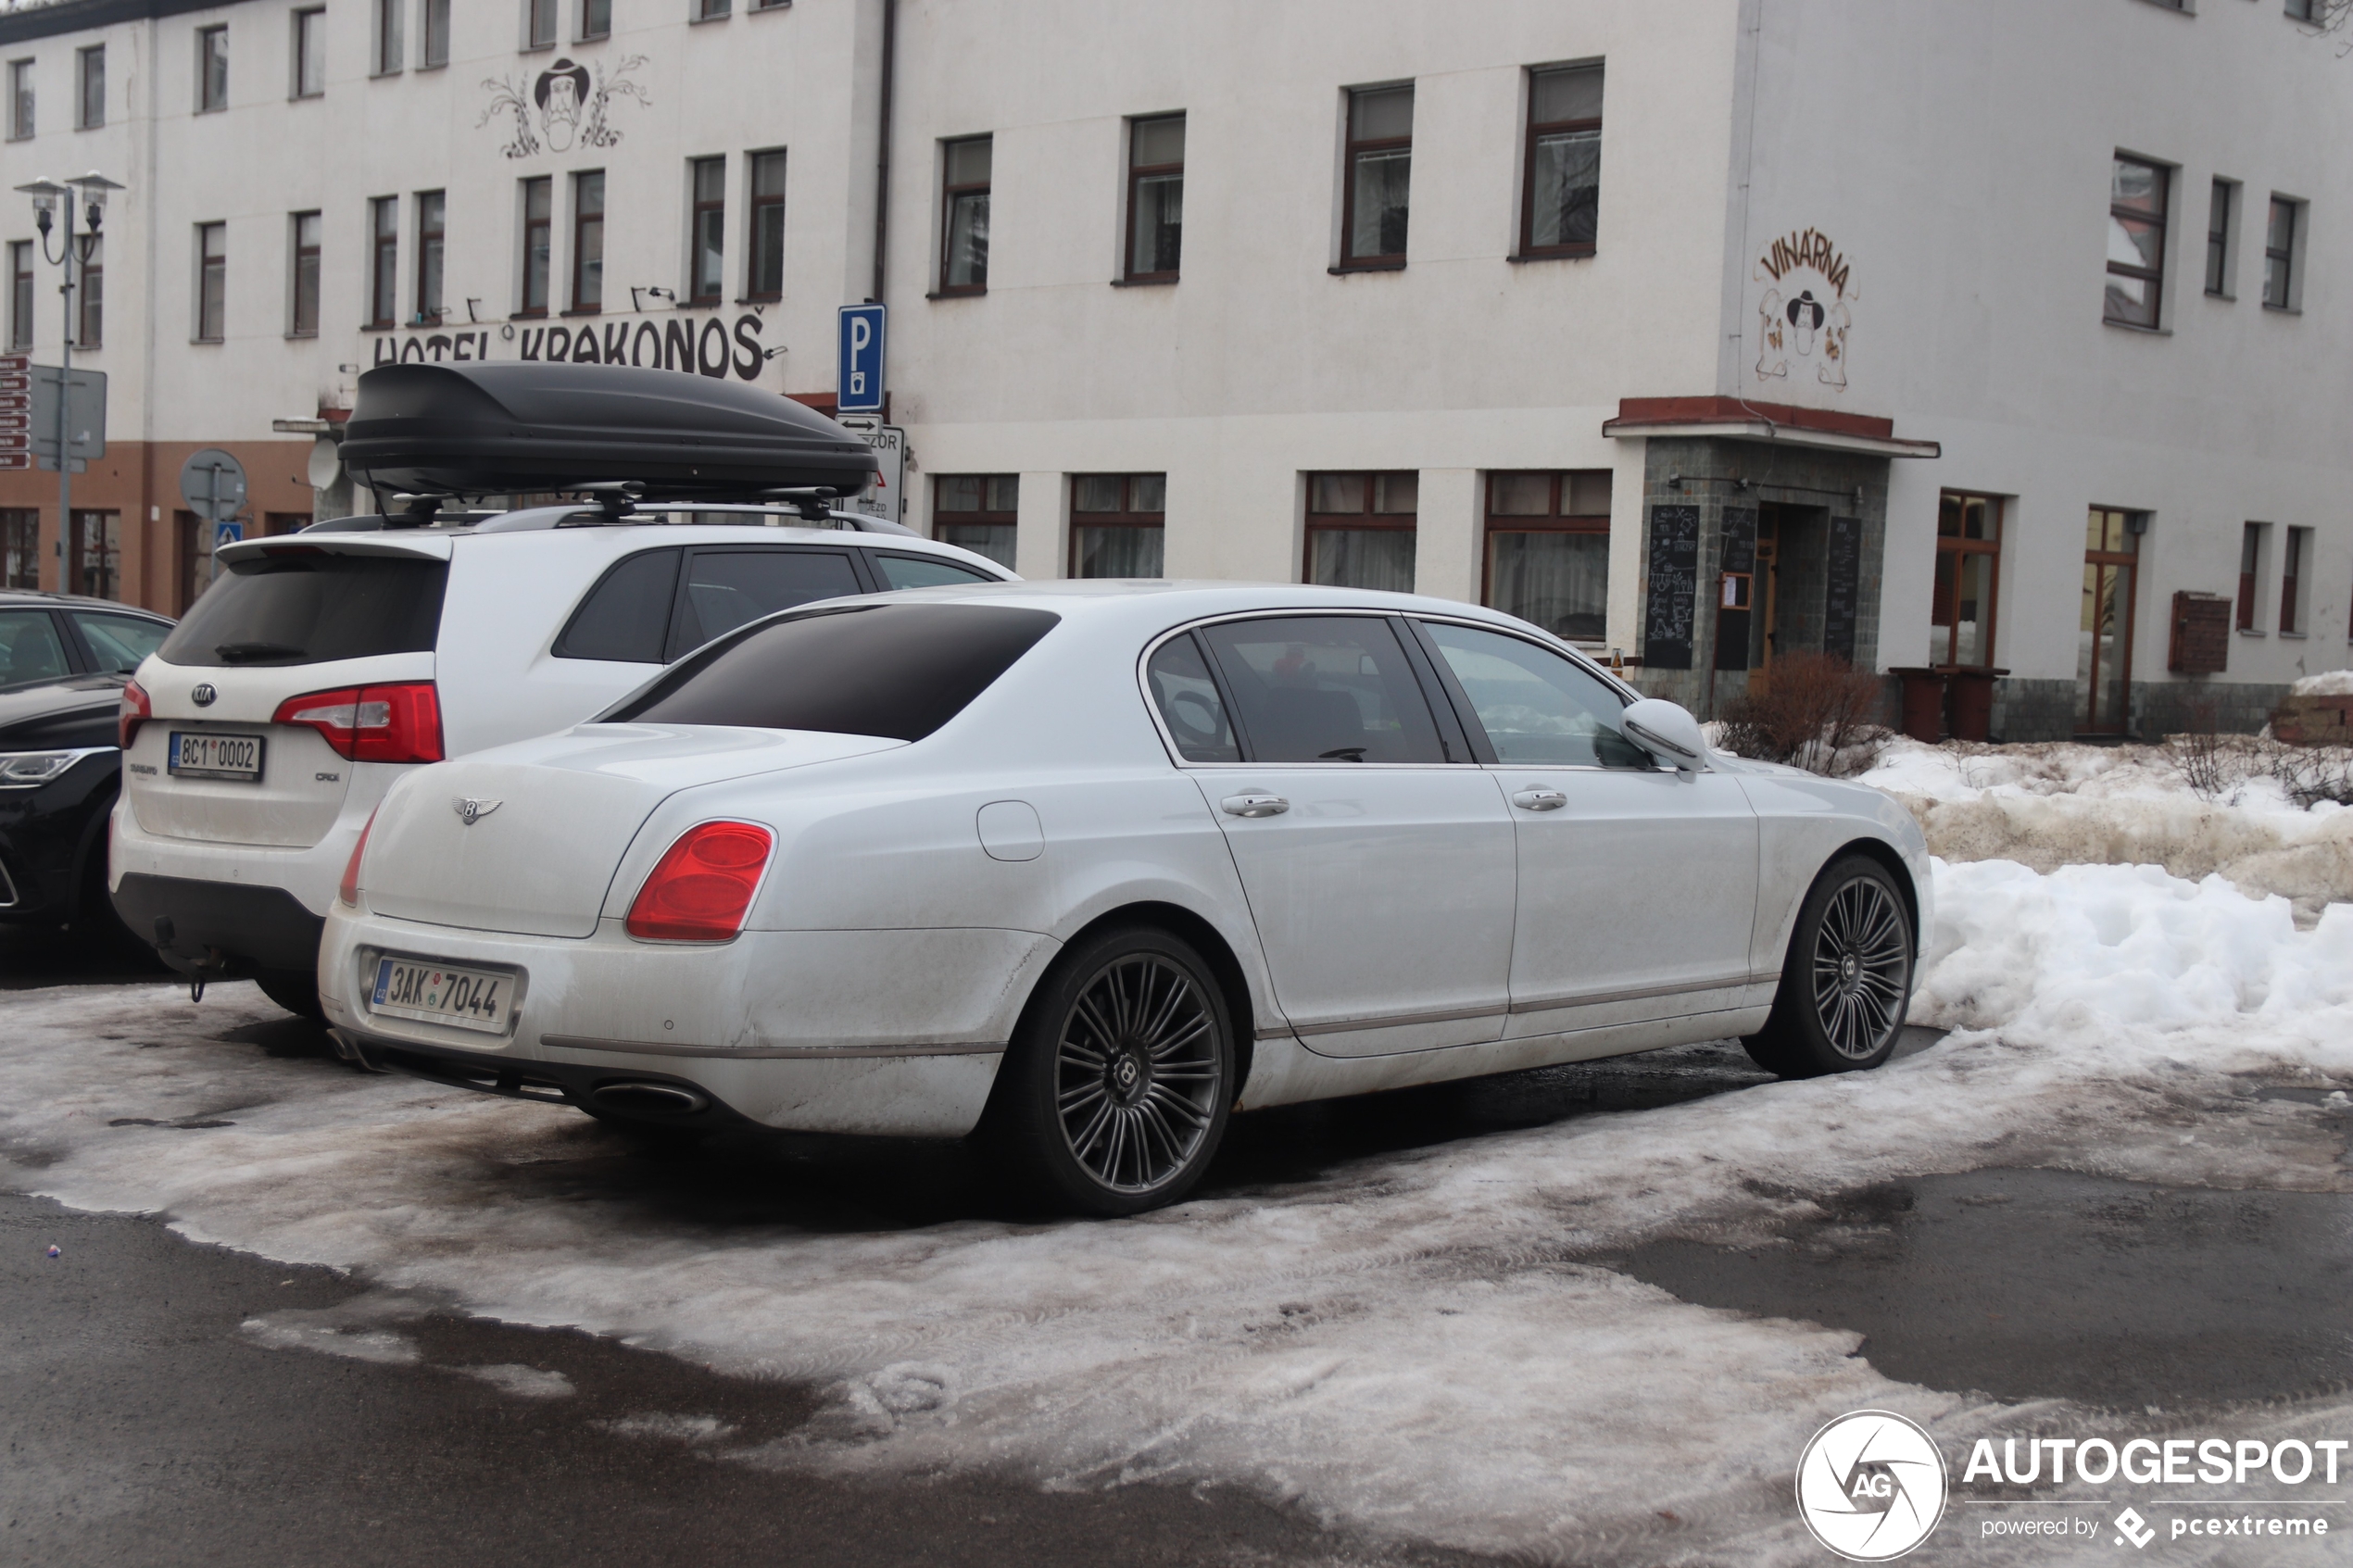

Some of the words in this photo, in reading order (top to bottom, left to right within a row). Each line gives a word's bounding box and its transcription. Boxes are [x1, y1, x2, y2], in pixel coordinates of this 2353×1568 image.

[1760, 226, 1849, 298] VINÁRNA
[850, 316, 871, 371] P
[870, 433, 897, 450] ZOR
[194, 686, 212, 701] KIA
[182, 738, 207, 765] 8C1
[219, 740, 253, 768] 0002
[376, 988, 386, 999] CZ
[391, 967, 430, 1004] 3AK
[440, 973, 498, 1017] 7044
